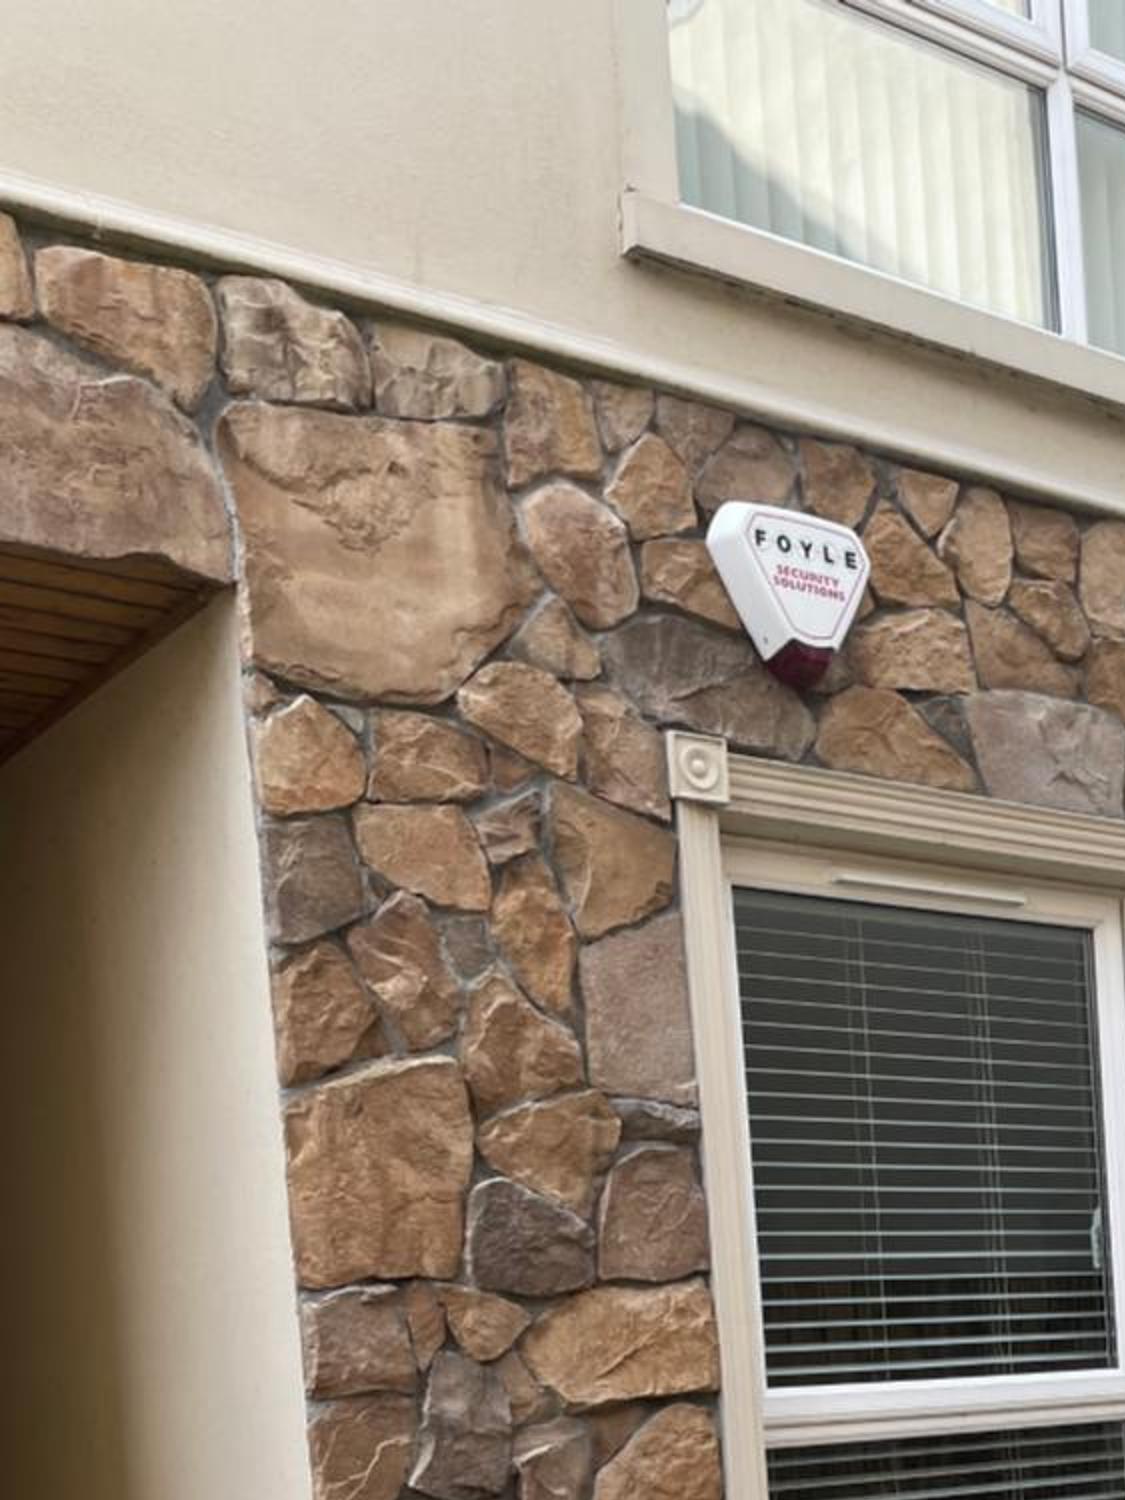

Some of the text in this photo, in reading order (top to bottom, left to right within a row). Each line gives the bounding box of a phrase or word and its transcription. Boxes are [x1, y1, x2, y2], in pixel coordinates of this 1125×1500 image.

[755, 529, 857, 569] FOYLE
[773, 574, 846, 601] SOLUTIONS
[776, 564, 839, 587] SECURITY
